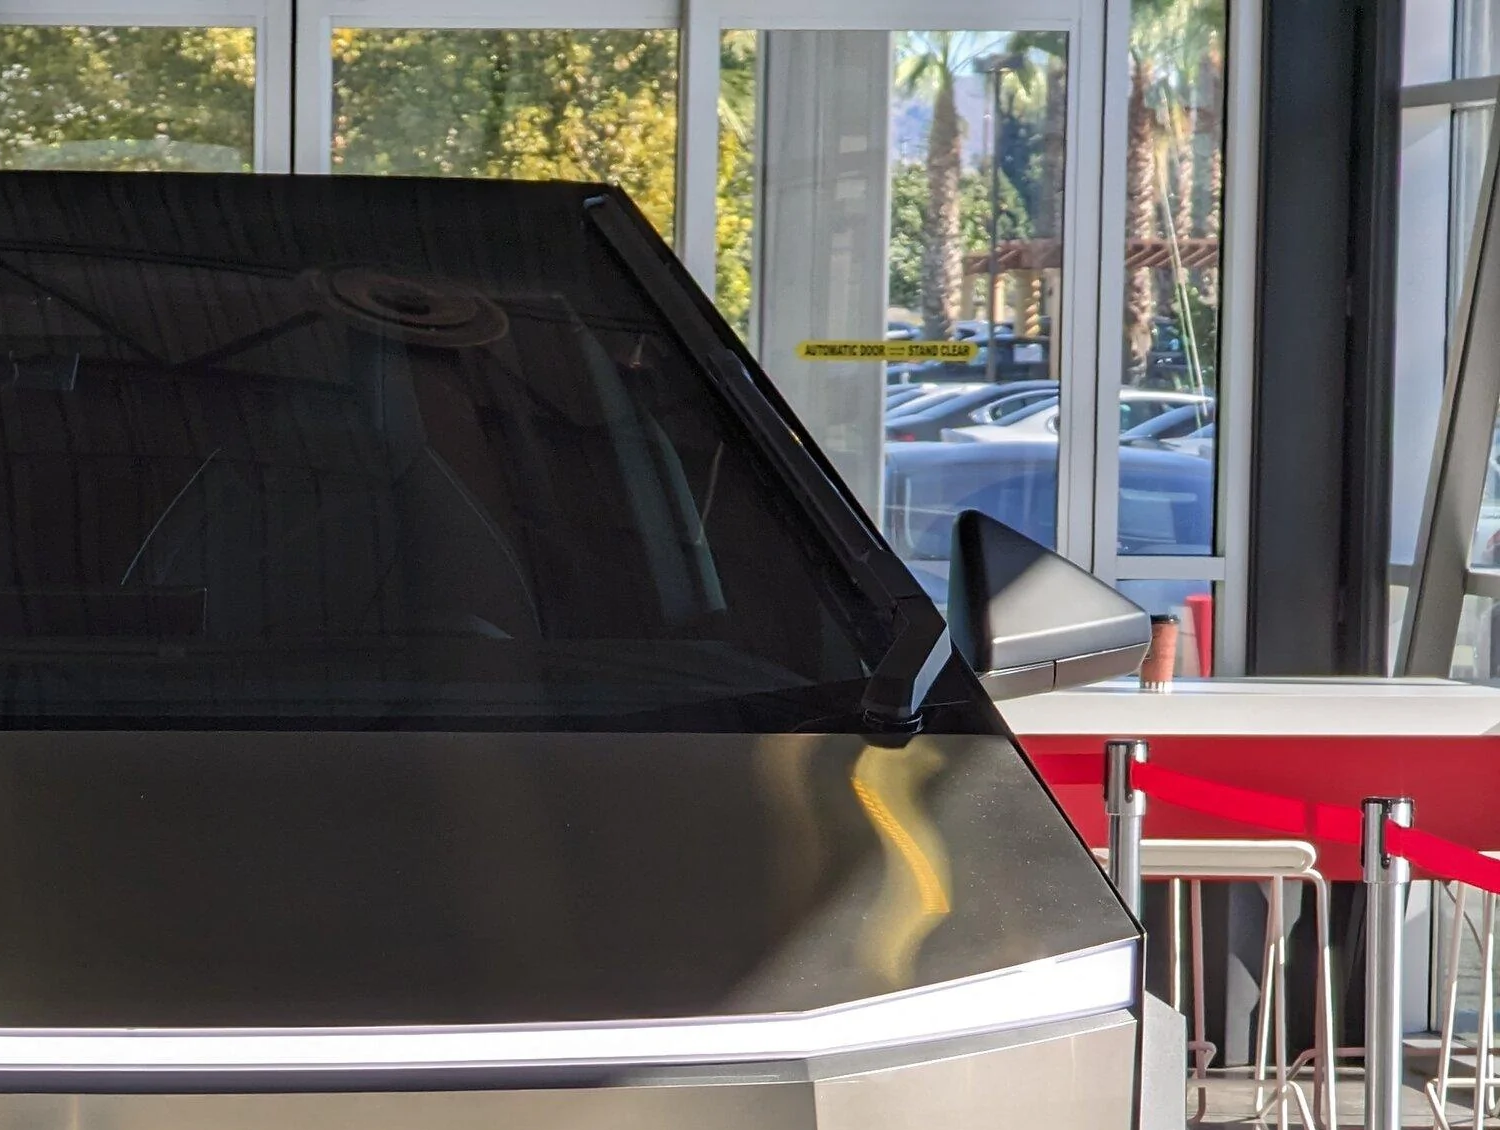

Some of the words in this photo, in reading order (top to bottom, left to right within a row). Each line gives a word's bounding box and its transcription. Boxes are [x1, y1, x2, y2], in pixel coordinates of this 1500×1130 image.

[805, 344, 857, 356] AUTOMATIC
[860, 344, 886, 356] DOOR
[908, 344, 939, 356] STAND
[940, 344, 971, 356] CLEAR
